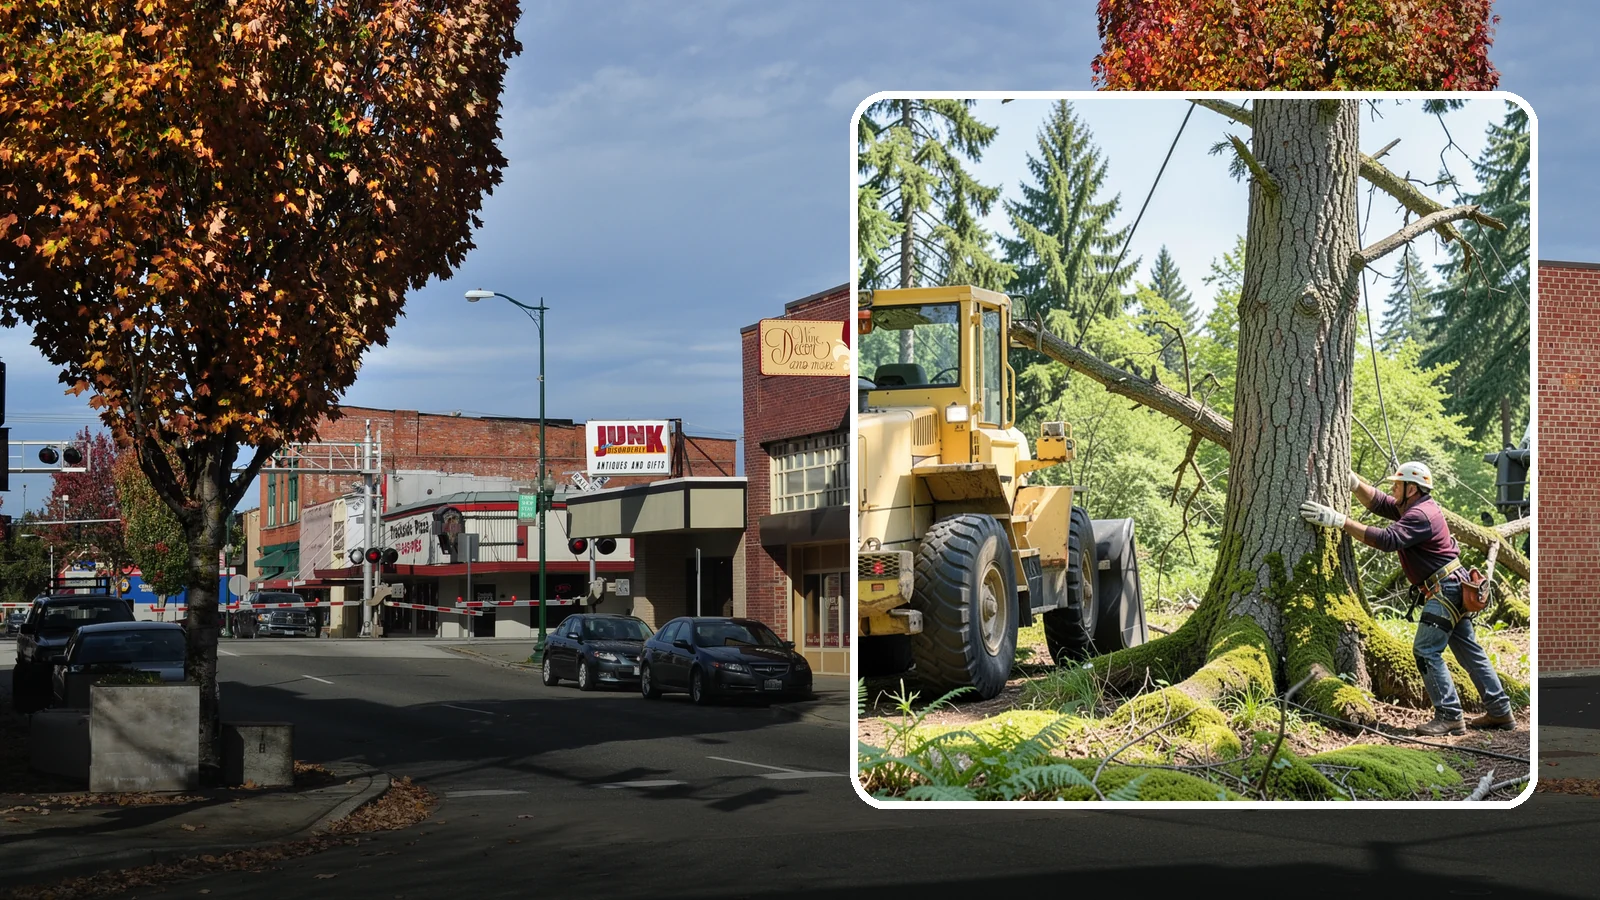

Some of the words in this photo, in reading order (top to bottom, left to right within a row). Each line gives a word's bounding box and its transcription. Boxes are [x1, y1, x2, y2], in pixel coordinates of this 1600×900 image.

[765, 327, 831, 365] Decor
[595, 425, 665, 457] JUNK
[607, 446, 646, 454] DISORDERLY
[596, 461, 628, 470] ANTIQUES
[631, 461, 644, 470] AND
[647, 460, 665, 469] GIFTS
[573, 473, 589, 490] RAIL
